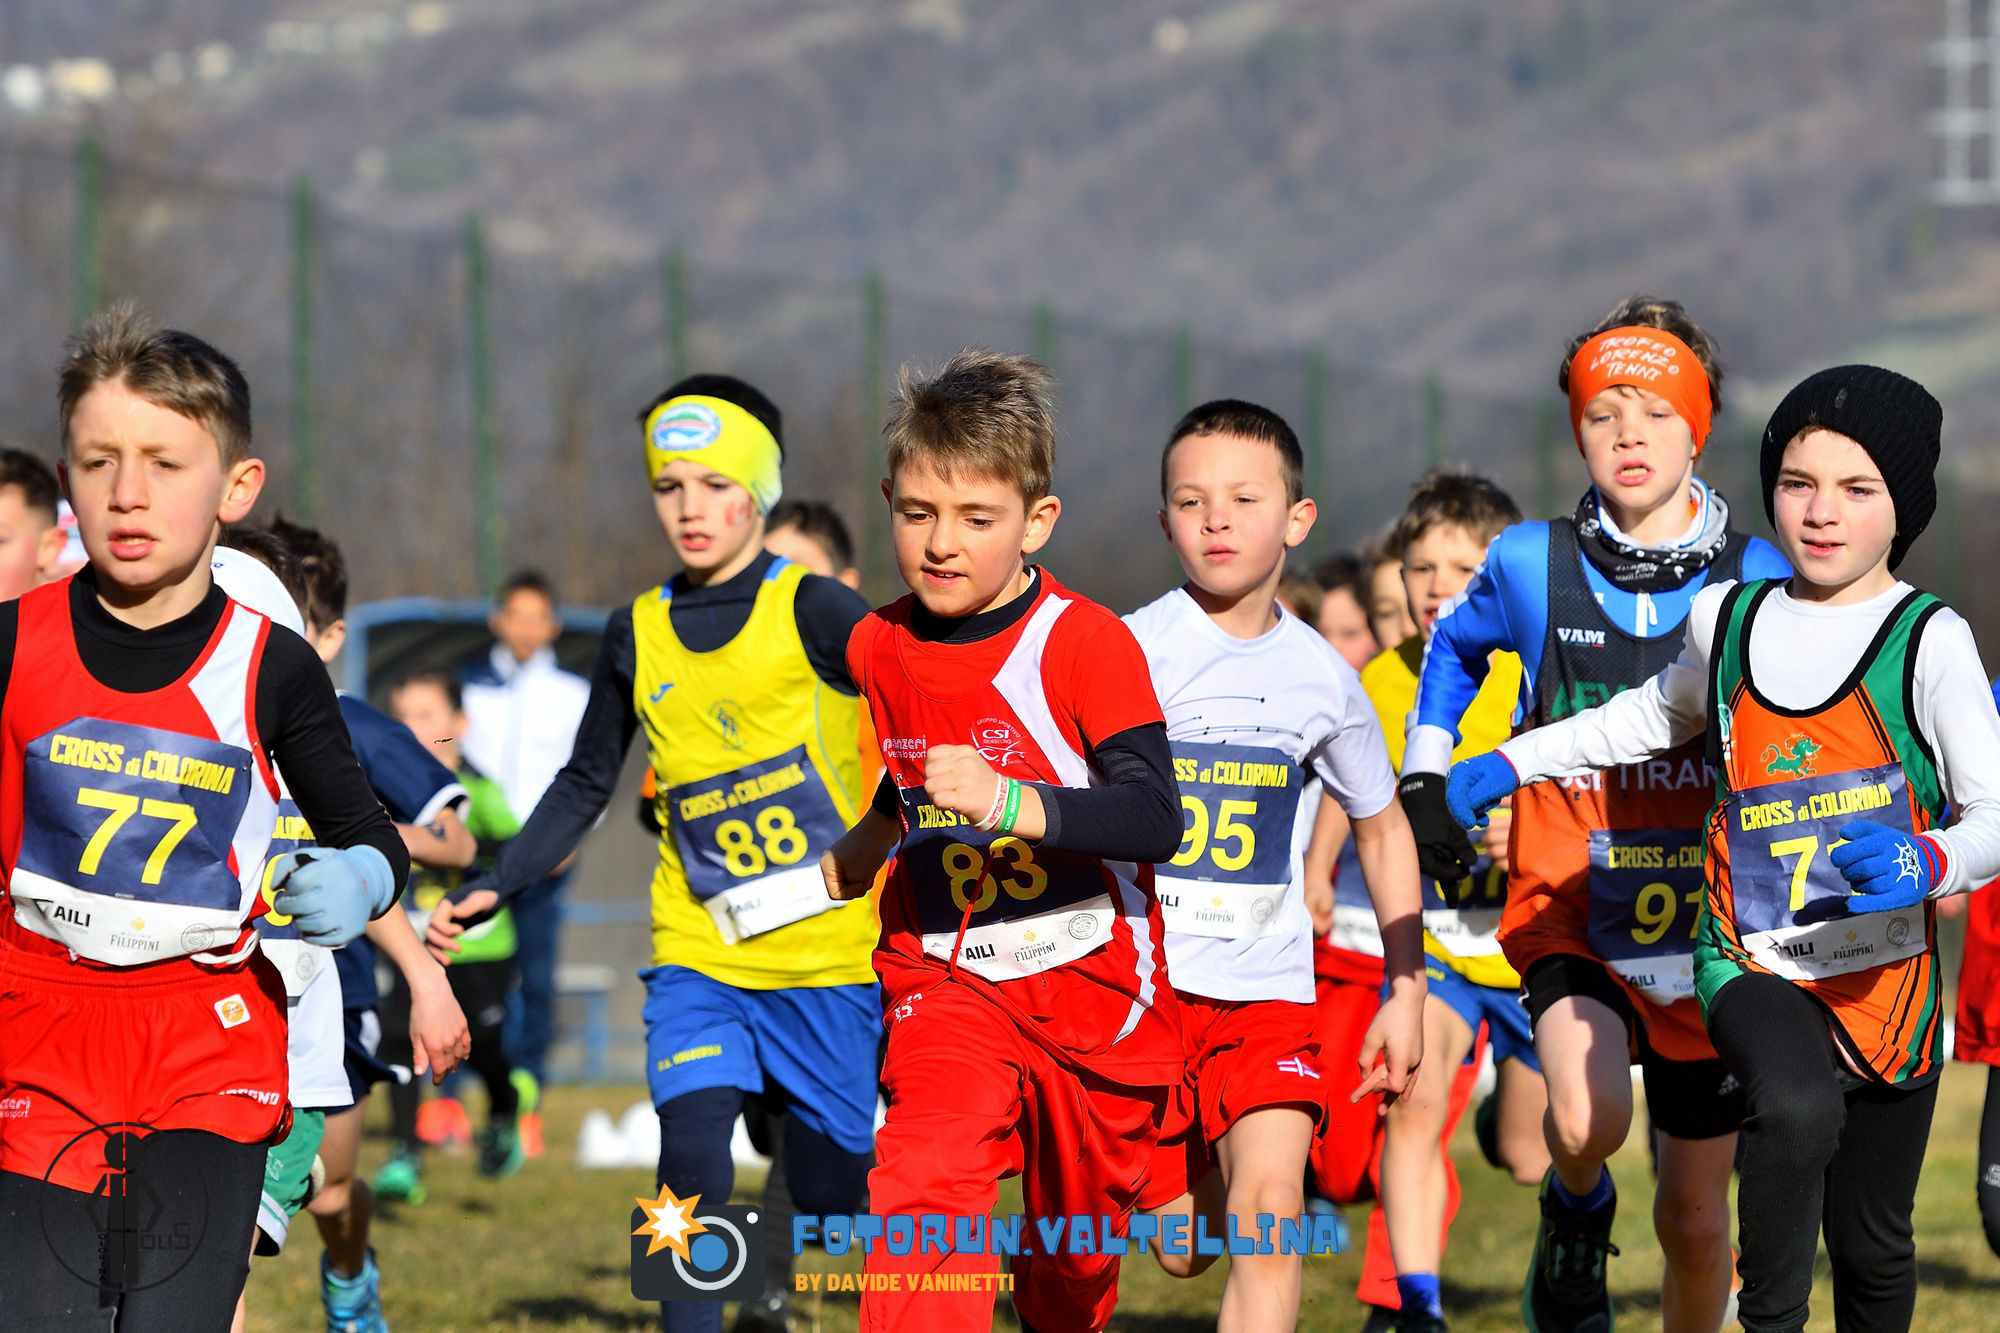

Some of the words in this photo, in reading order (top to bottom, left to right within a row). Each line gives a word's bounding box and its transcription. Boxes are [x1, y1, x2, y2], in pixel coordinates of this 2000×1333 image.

[1599, 335, 1677, 358] TROFEO
[1590, 348, 1680, 375] LORENZO
[1606, 361, 1662, 381] TENNI
[1557, 627, 1606, 645] VAM
[883, 737, 927, 752] panzeri
[982, 729, 1010, 739] CSI
[50, 734, 125, 773] CROSS
[125, 757, 141, 776] di
[142, 750, 236, 794] COLORINA
[908, 750, 927, 761] sport
[1200, 768, 1212, 783] di
[1213, 761, 1288, 788] COLORINA
[917, 805, 958, 829] CROSS
[1740, 799, 1795, 831] CROSS
[1797, 804, 1810, 822] di
[1809, 783, 1893, 819] COLORINA
[76, 787, 198, 886] 77
[715, 805, 808, 878] 88
[1168, 795, 1258, 872] 95
[1608, 846, 1664, 868] CROSS
[1667, 852, 1678, 868] di
[942, 836, 1048, 913] 83
[1770, 835, 1851, 912] 7
[53, 905, 91, 927] AILI
[1630, 882, 1705, 945] 91
[110, 934, 160, 951] FILIPPINI
[965, 944, 995, 960] AILI
[1014, 942, 1057, 962] FILIPPINI
[1833, 943, 1874, 960] FILIPPINI
